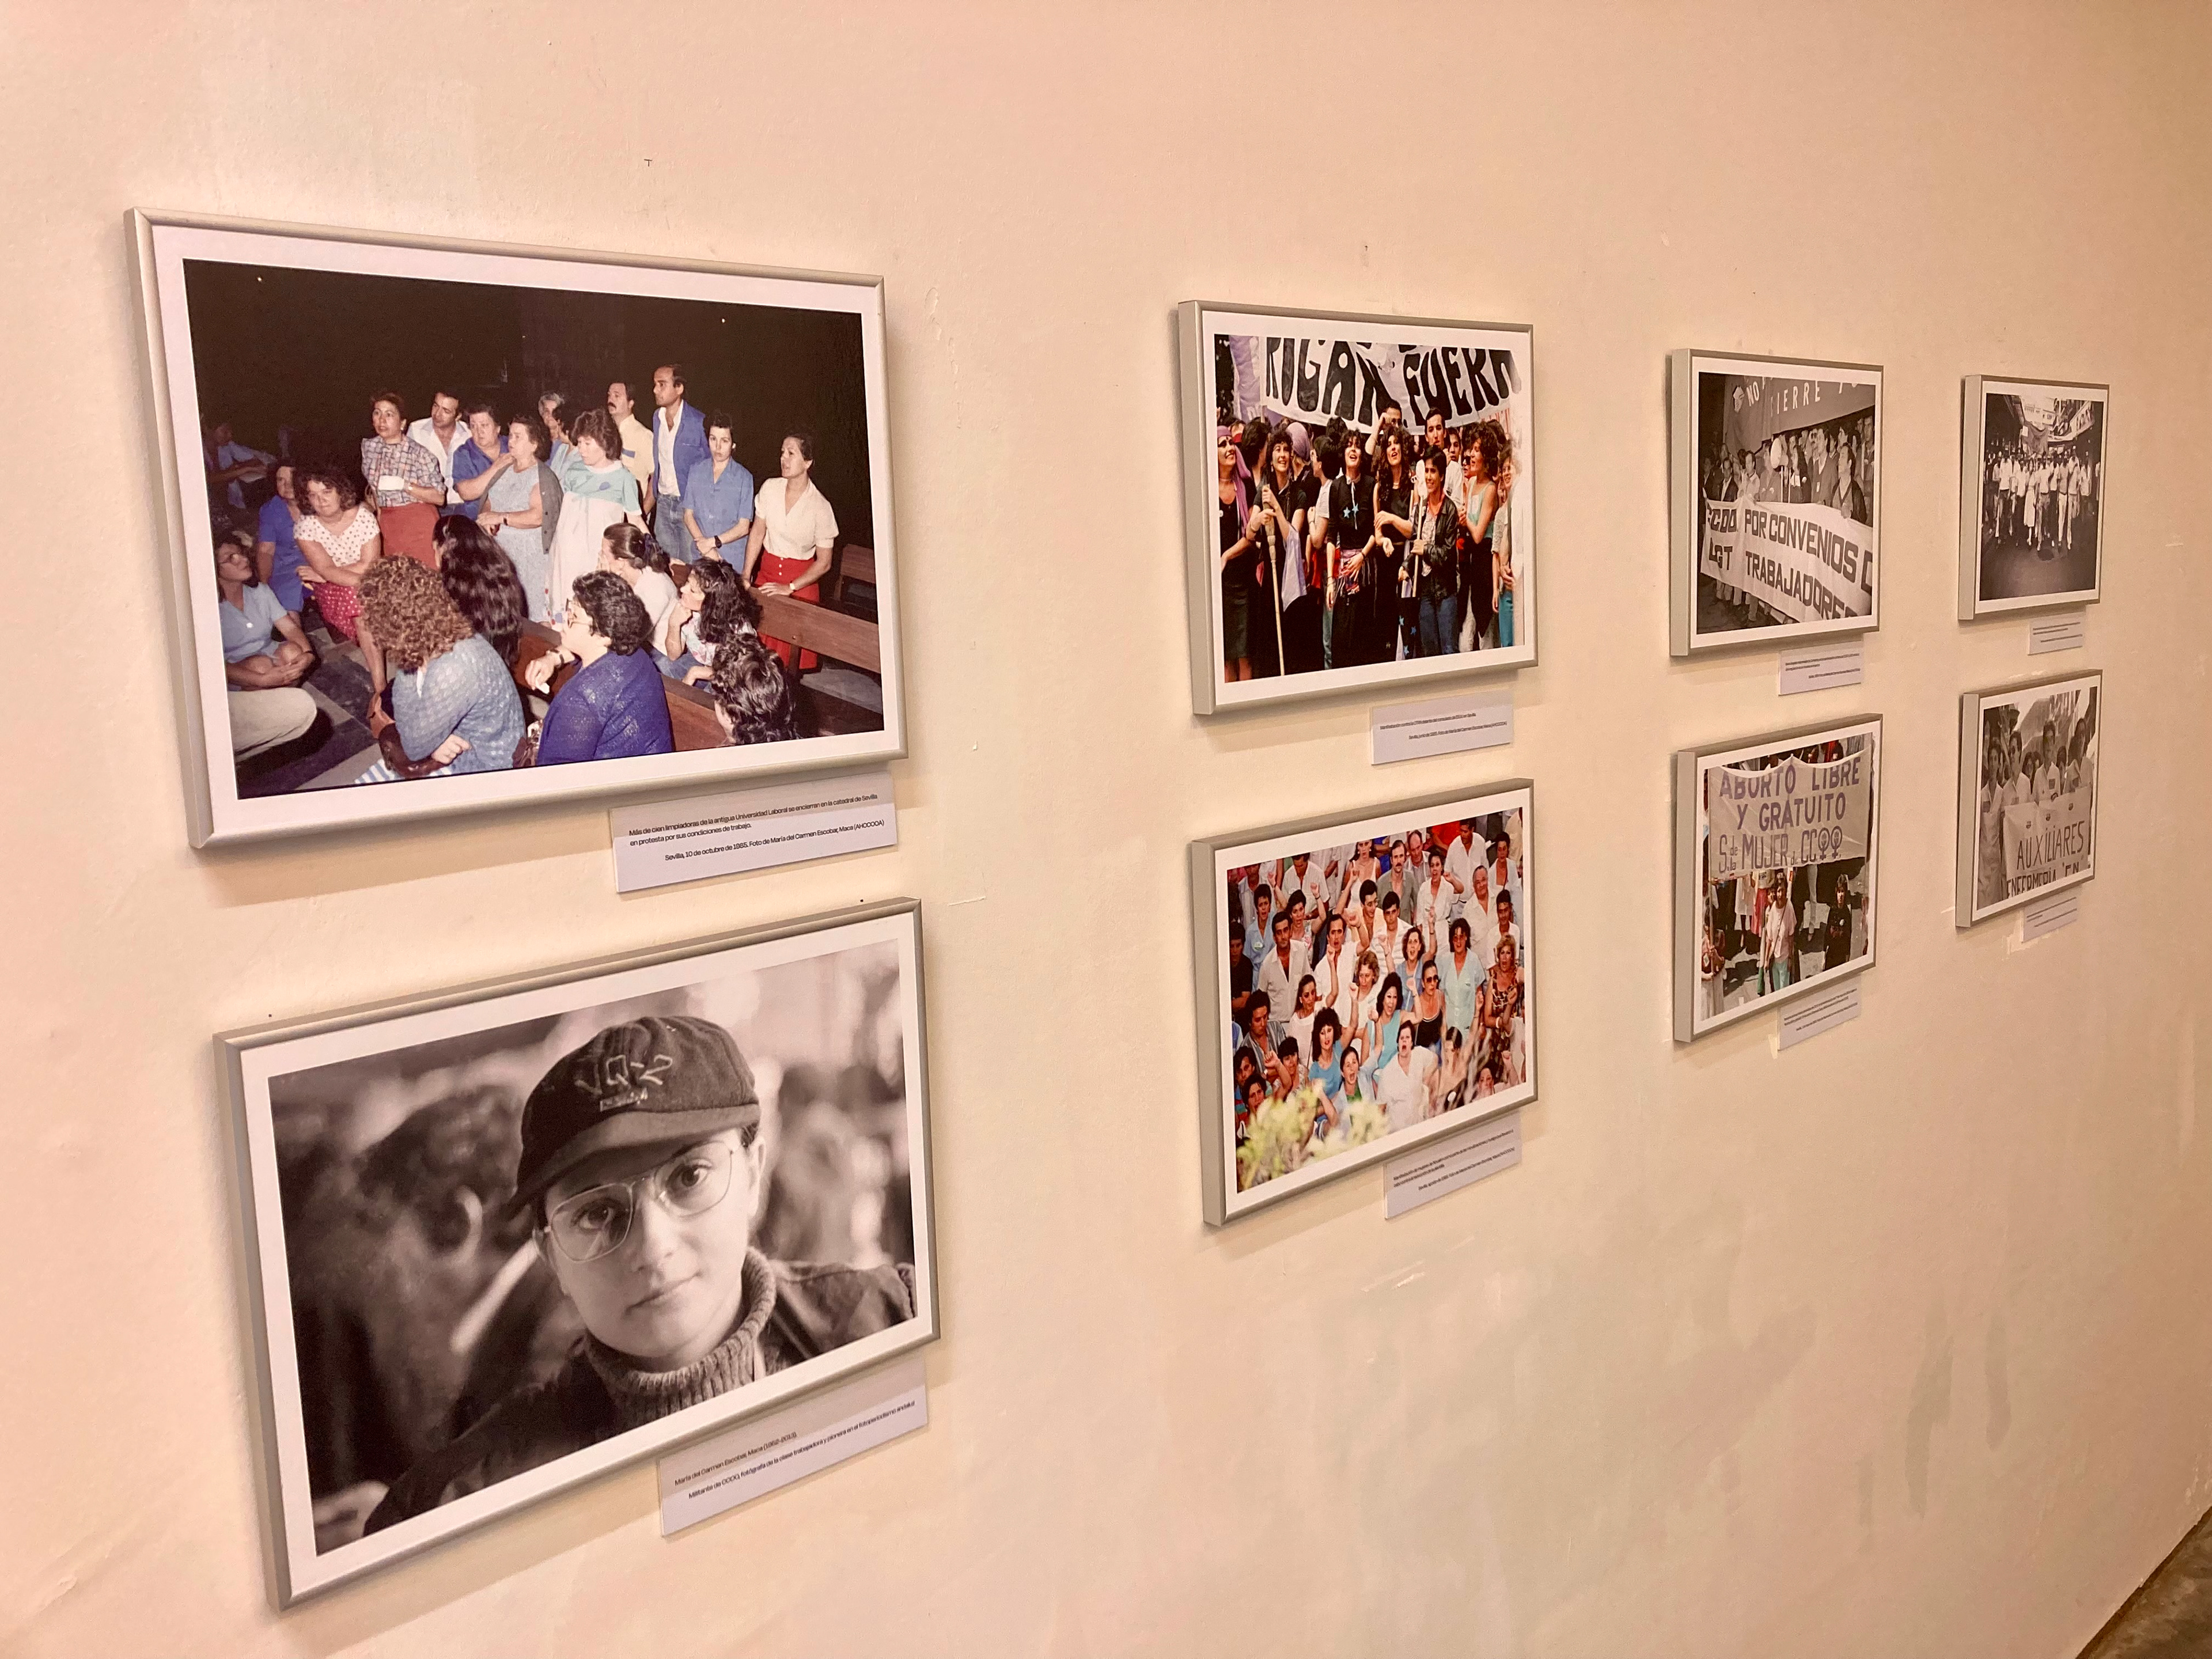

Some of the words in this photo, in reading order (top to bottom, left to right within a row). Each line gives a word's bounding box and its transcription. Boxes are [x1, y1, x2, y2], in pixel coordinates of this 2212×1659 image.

[1770, 380, 1820, 417] IERRE
[1745, 509, 1767, 539] POR
[1769, 513, 1859, 583] CONVENIOS
[1719, 764, 1796, 800] ABORTO
[1812, 756, 1861, 791] LIBRE
[665, 821, 699, 831] limpiadoras
[714, 816, 735, 824] antigua
[735, 809, 767, 820] Universidad
[768, 807, 787, 815] Laboral
[833, 797, 854, 805] catedral
[1737, 804, 1748, 830] Y
[1759, 792, 1846, 831] GRATUITO
[638, 836, 665, 846] protesta
[687, 827, 722, 837] condiciones
[730, 822, 752, 831] trabajo.
[665, 851, 685, 861] Sevilla,
[702, 846, 724, 855] octubre
[770, 835, 786, 843] María
[795, 831, 817, 839] Carmen
[817, 828, 839, 836] Escobar,
[1741, 834, 1789, 870] MUJER
[700, 1462, 724, 1475] Carmen
